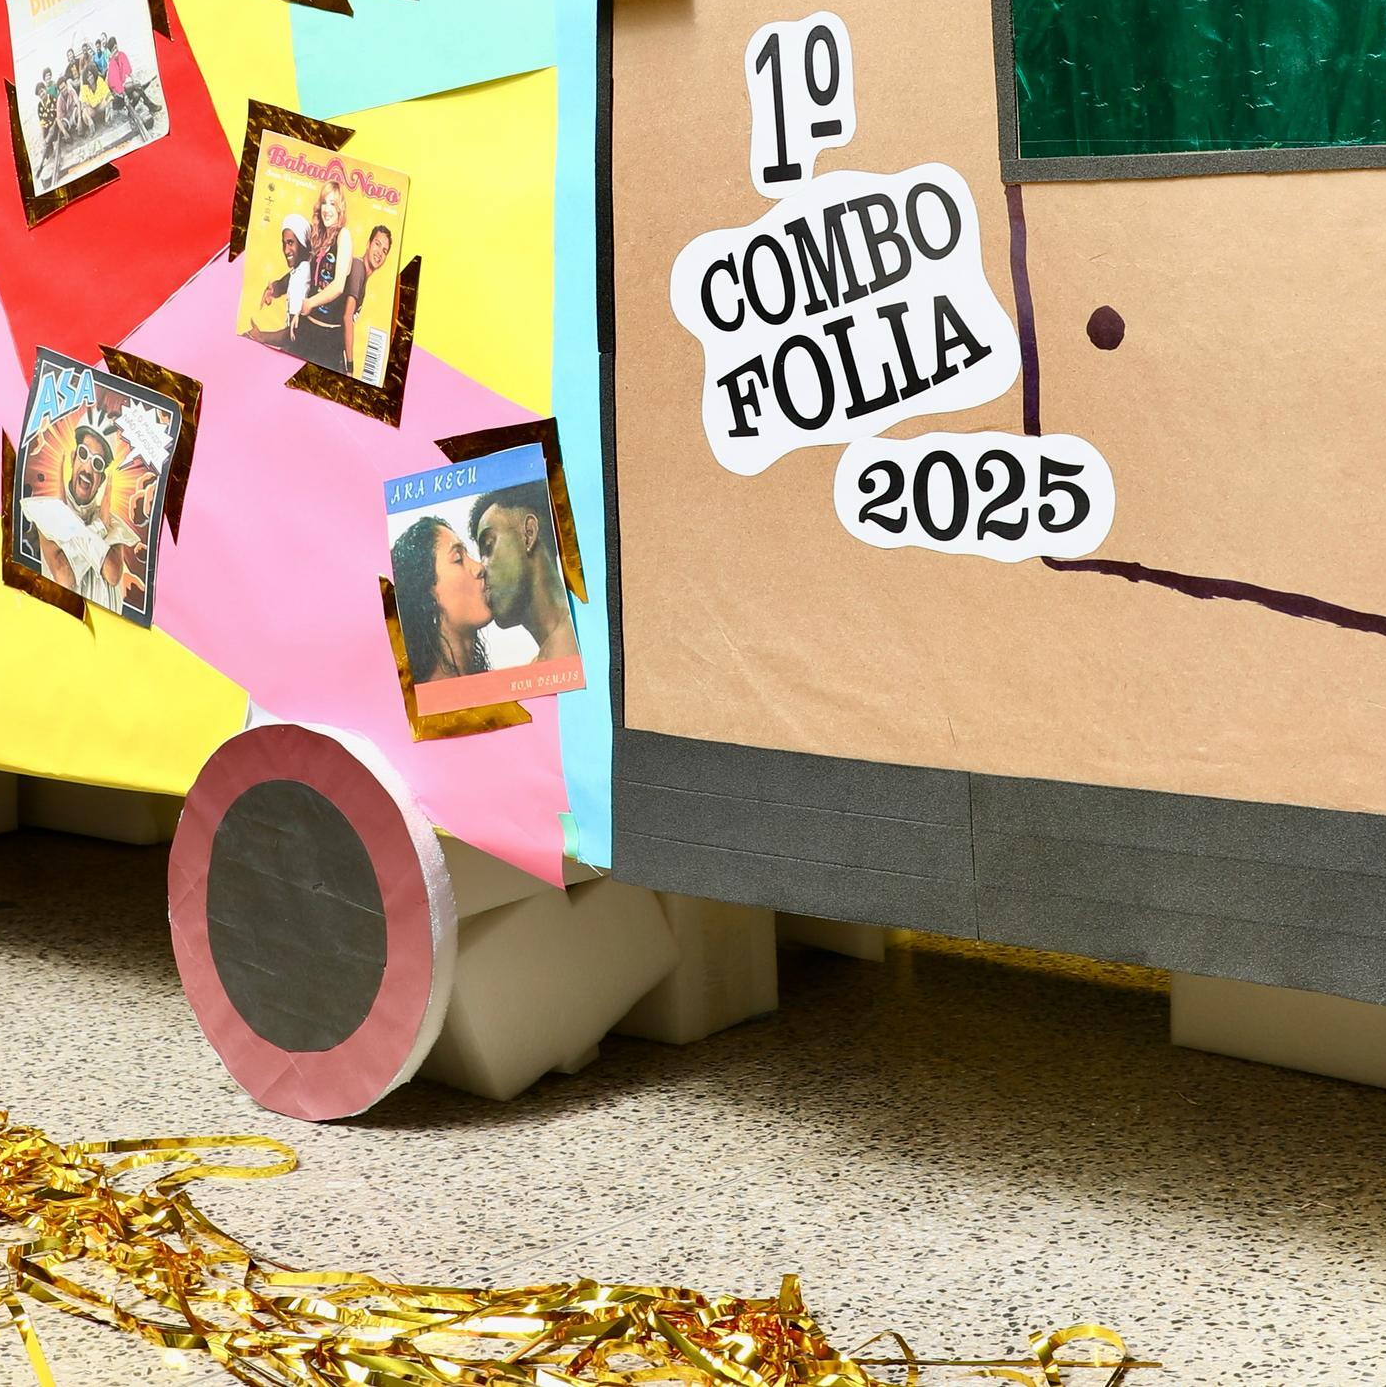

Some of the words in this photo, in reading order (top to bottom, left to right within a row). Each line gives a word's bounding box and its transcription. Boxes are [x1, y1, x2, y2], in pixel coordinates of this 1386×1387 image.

[700, 181, 963, 333] COMBO
[23, 368, 96, 437] ASA
[716, 294, 993, 438] FOLIA
[390, 477, 426, 505] ARA
[433, 466, 478, 495] KETU
[857, 449, 1091, 541] 2025
